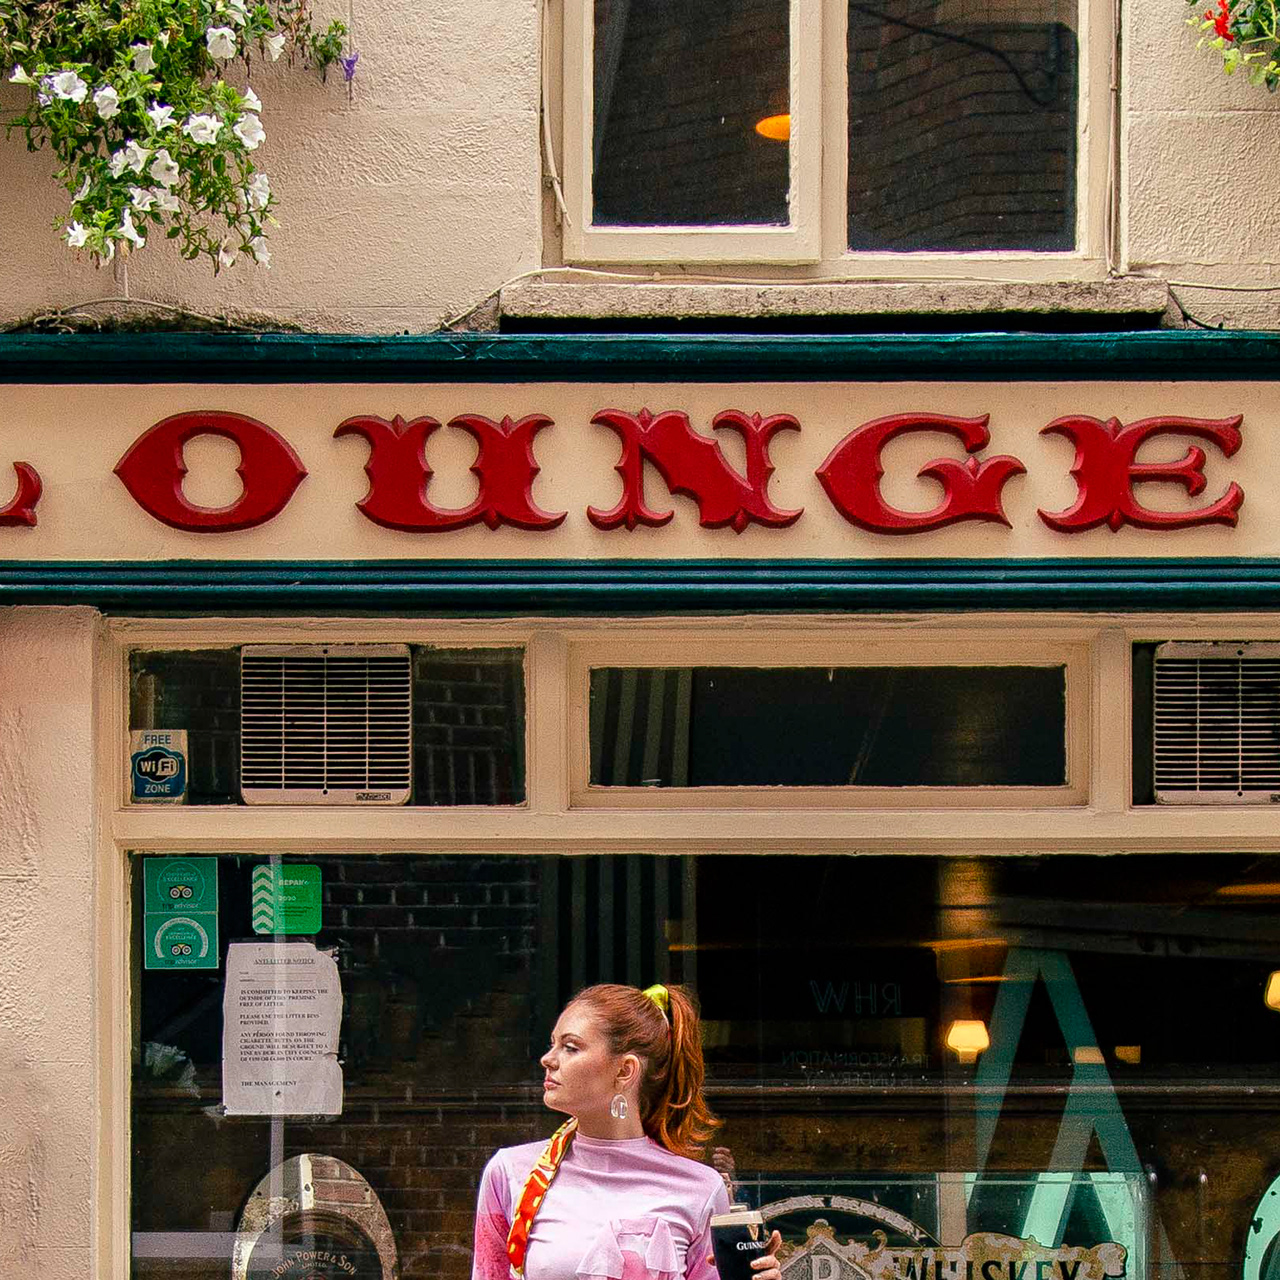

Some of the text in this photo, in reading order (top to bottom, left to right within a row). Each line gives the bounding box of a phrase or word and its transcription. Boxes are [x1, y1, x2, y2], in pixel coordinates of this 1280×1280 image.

[144, 734, 171, 745] FREE
[144, 784, 171, 794] ZONE
[272, 1258, 295, 1279] JOHN
[295, 1251, 330, 1262] POWER
[338, 1255, 358, 1275] SON
